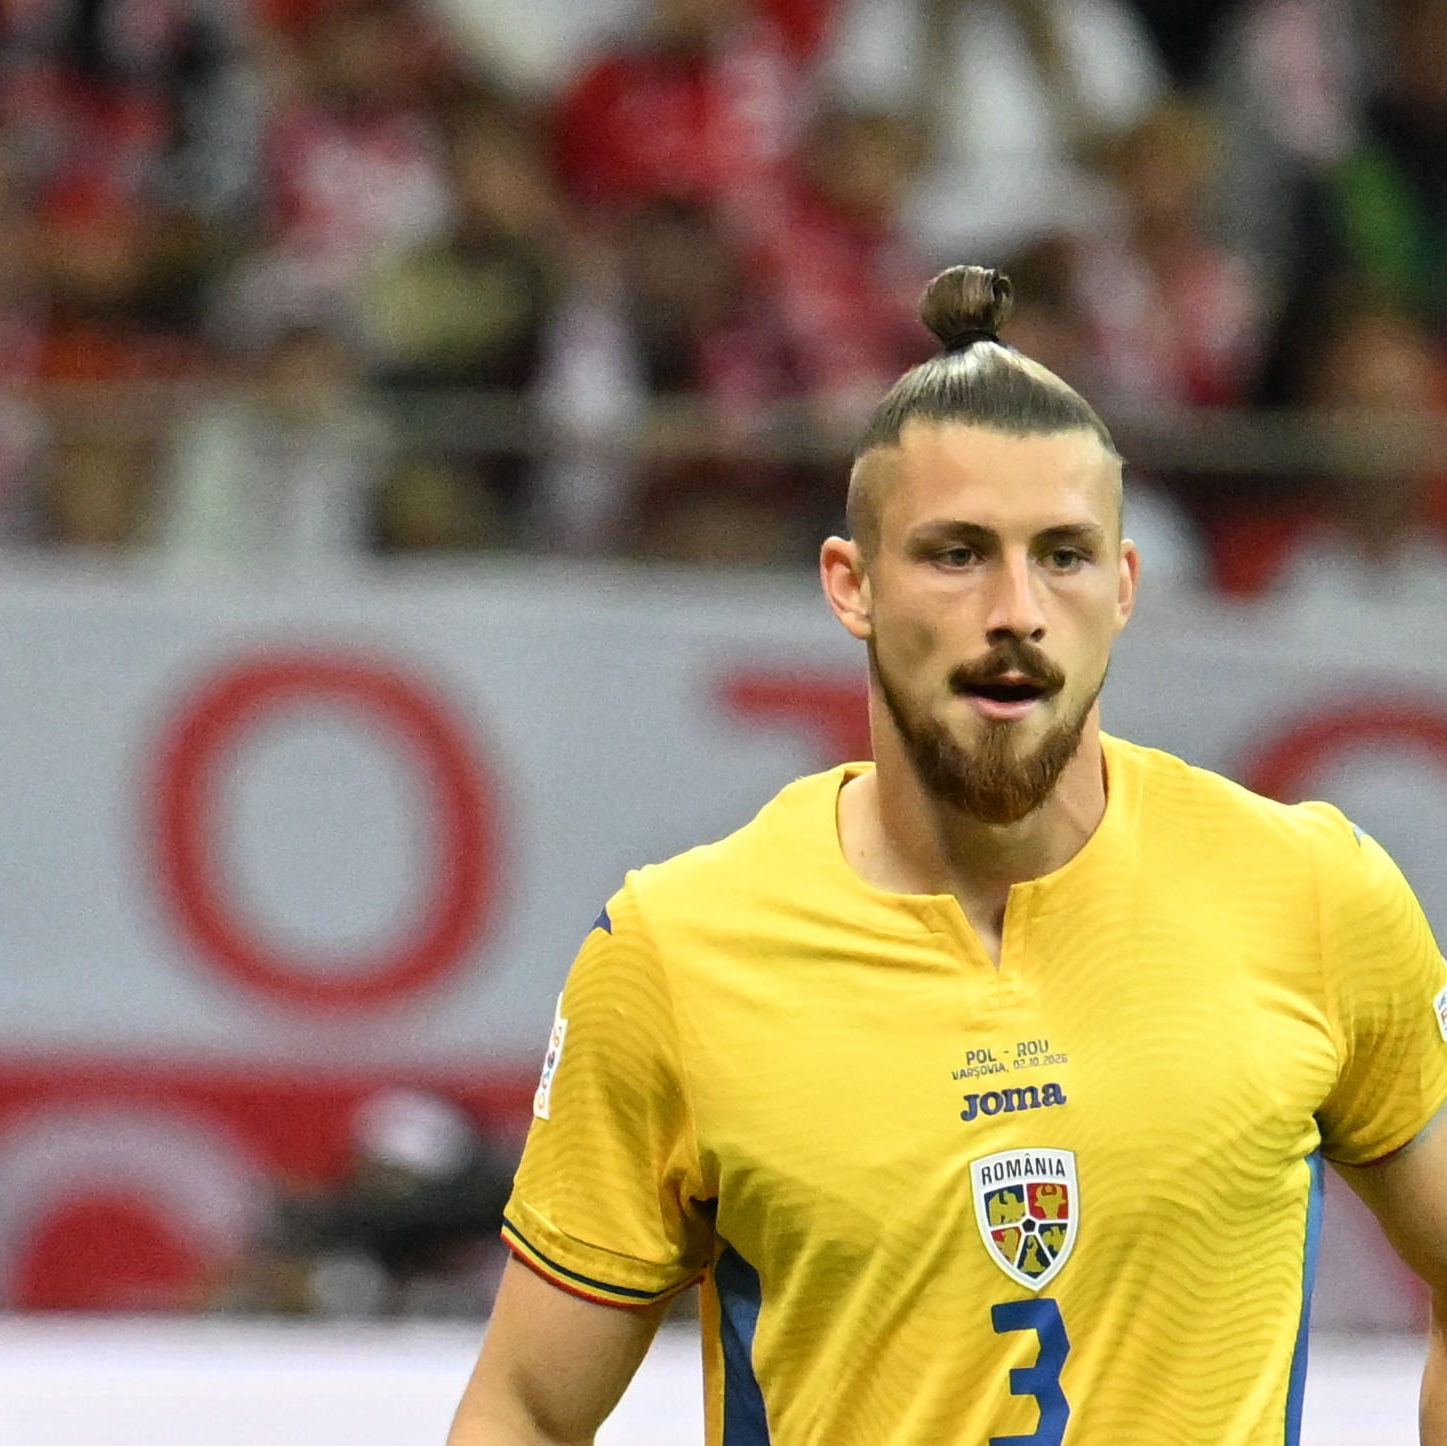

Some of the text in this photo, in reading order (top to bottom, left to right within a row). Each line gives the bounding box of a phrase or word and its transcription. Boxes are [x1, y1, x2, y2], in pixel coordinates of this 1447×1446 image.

[965, 1048, 997, 1066] POL
[1016, 1039, 1050, 1058] ROU
[981, 1153, 1066, 1185] ROMÂNIA
